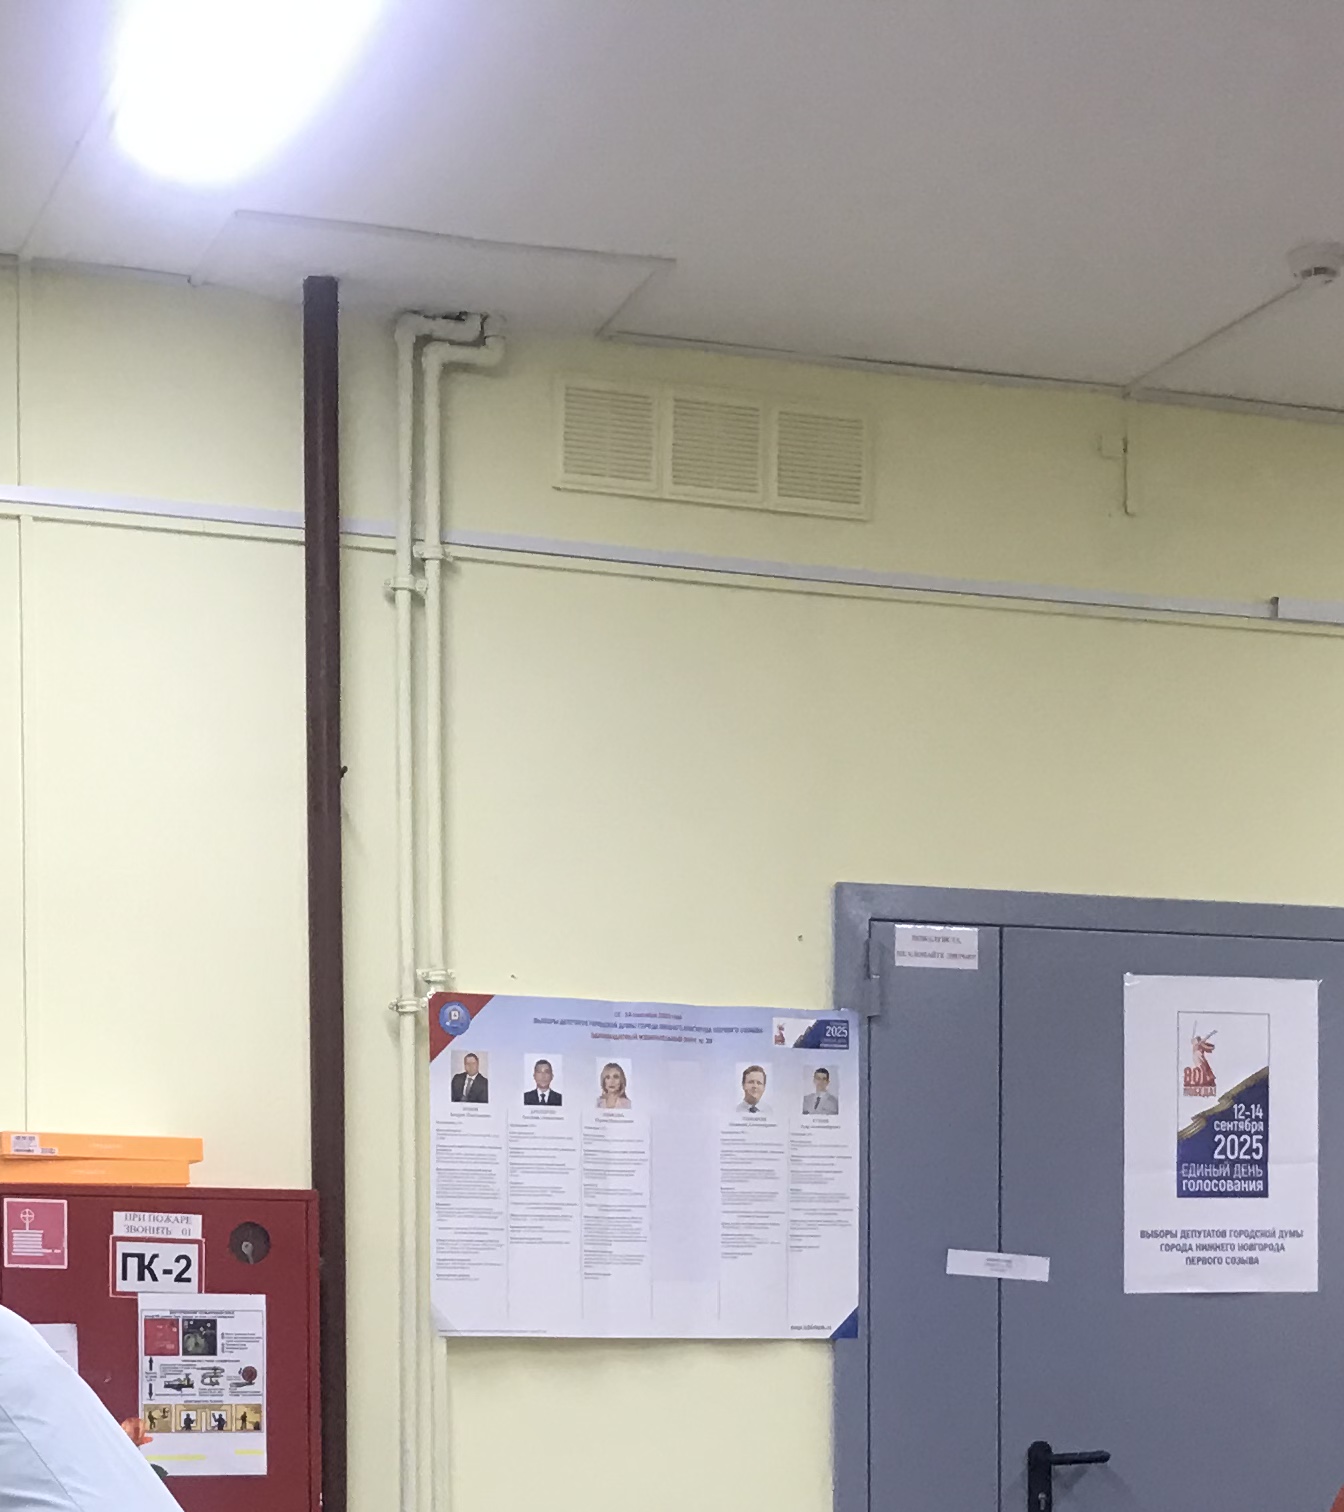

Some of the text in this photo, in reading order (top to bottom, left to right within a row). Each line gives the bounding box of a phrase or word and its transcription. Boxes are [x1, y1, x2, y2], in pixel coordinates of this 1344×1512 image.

[825, 1026, 848, 1038] 2025
[1232, 1103, 1264, 1120] 12-14
[1213, 1118, 1265, 1134] сентября
[1213, 1134, 1264, 1161] 2025
[1181, 1161, 1264, 1179] ЕДИНЫЙ ДЕНЬ
[1182, 1179, 1265, 1192] голосования
[124, 1212, 193, 1226] ПРИ ПОЖАРЕ
[123, 1224, 173, 1237] ЗВОНИТЬ
[1139, 1229, 1178, 1239] ВЫБОРЫ
[1180, 1229, 1227, 1240] ДЕПУТАТОВ
[1278, 1229, 1304, 1240] ДУМЫ
[1160, 1243, 1194, 1253] ГОРОДА
[1185, 1256, 1260, 1266] ПЕРВОГО СОЗЫВА
[121, 1252, 193, 1284] ПК-2
